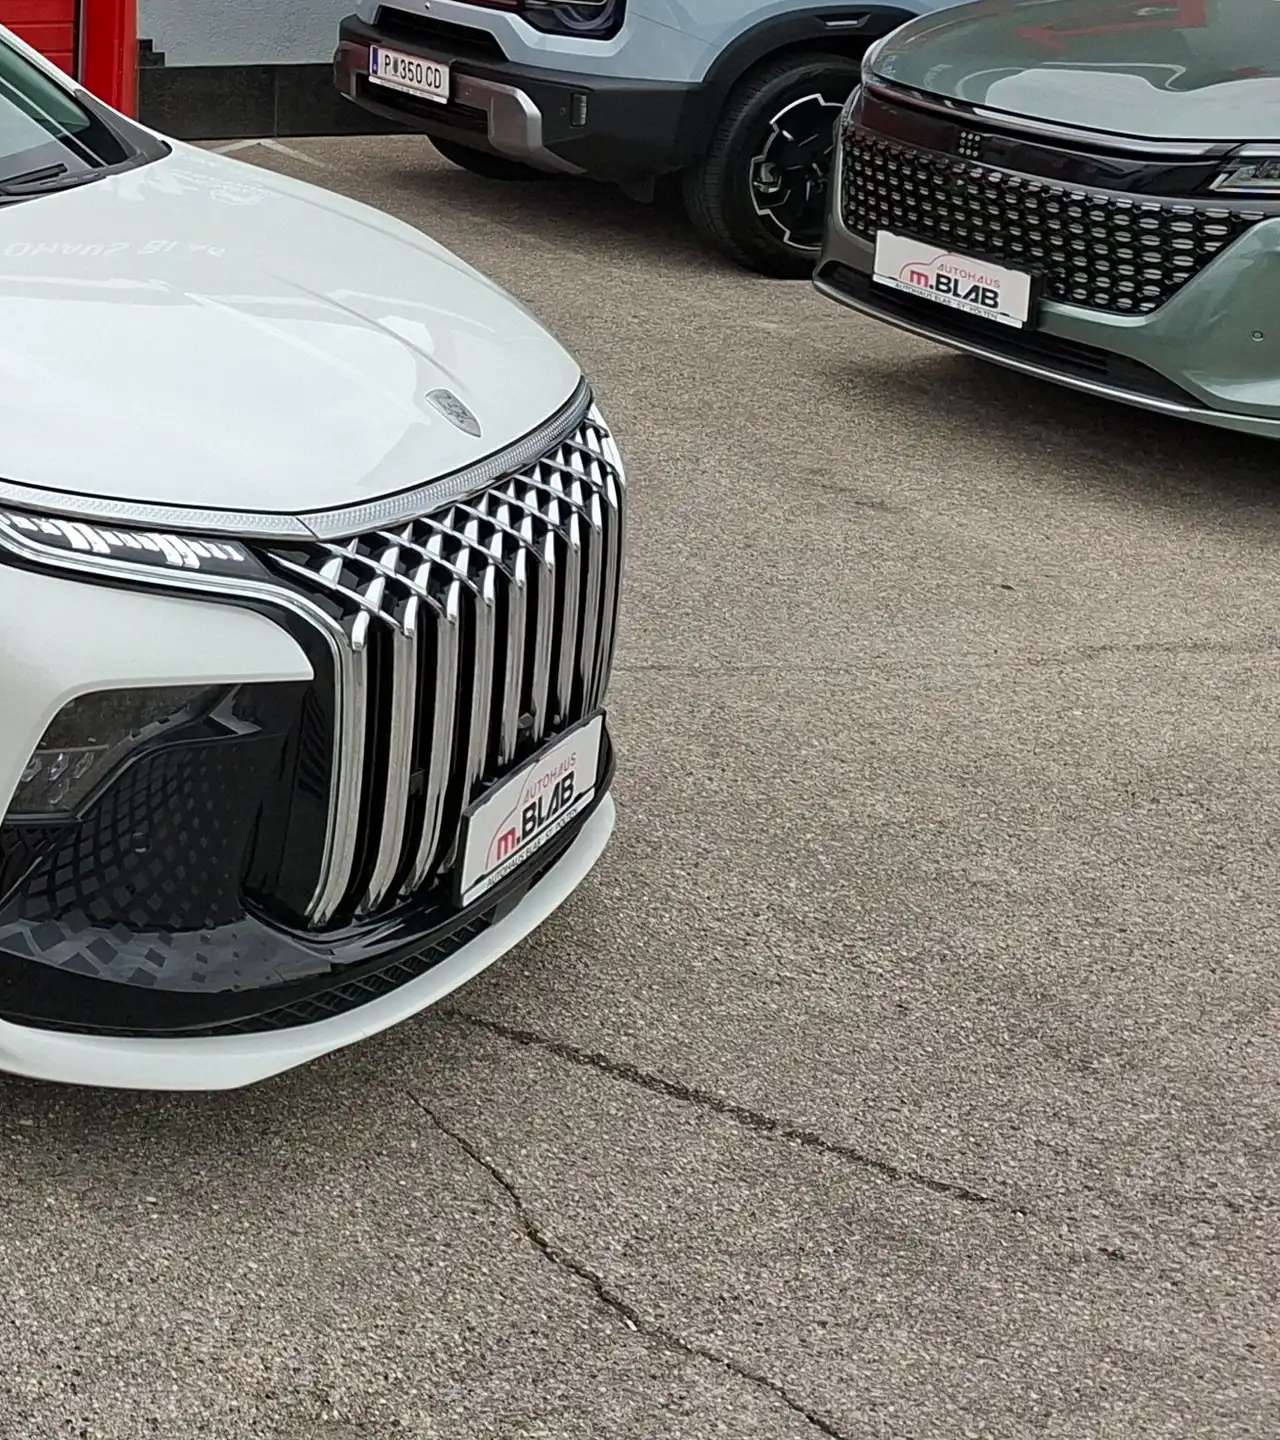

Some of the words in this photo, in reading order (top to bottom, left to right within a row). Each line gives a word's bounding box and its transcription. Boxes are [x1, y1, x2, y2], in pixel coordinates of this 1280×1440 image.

[384, 54, 391, 76] P
[400, 59, 423, 84] 350
[909, 269, 999, 309] m.BLAB
[937, 263, 1001, 289] AUTOHAUS
[523, 752, 577, 803] AUTOHAUS
[496, 770, 575, 861] m.BLAB
